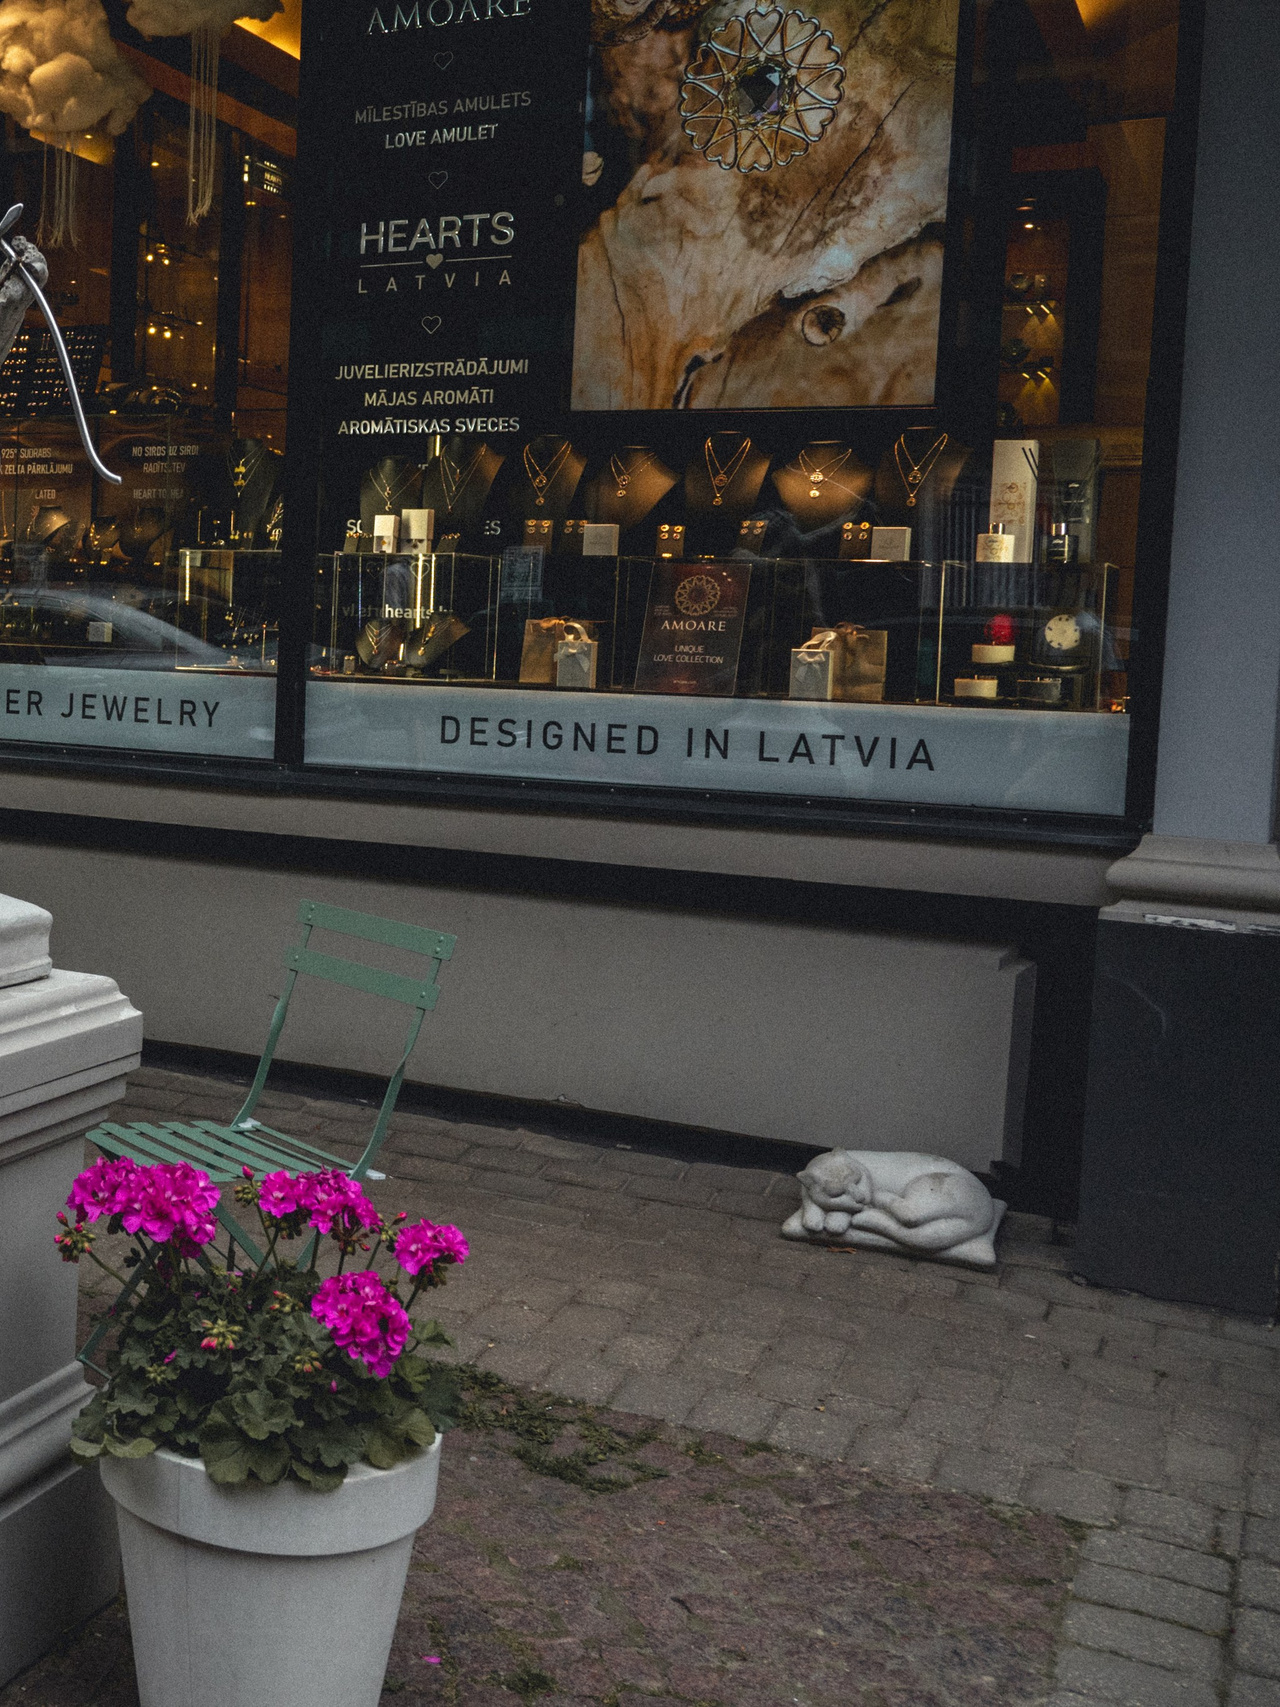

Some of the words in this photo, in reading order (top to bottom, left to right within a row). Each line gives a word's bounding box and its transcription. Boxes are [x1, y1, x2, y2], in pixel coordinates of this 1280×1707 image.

[366, 0, 532, 35] AMOARE
[354, 99, 449, 125] MĪLESTĪBAS
[453, 91, 532, 115] AMULETS
[384, 130, 426, 150] LOVE
[430, 123, 499, 146] AMULET
[359, 211, 516, 255] HEARTS
[358, 269, 513, 294] LATVIA
[334, 356, 529, 382] JUVELIERIZSTRĀDĀJUMI
[363, 387, 417, 407] MĀJAS
[421, 386, 494, 406] AROMĀTI
[338, 417, 451, 436] AROMĀTISKAS
[455, 416, 521, 434] SVECES
[661, 619, 727, 632] AMOARE
[653, 654, 673, 662] LOVE
[675, 654, 724, 664] COLLECTION
[674, 644, 705, 654] UNIQUE
[60, 692, 221, 728] JEWELRY
[440, 715, 660, 756] DESIGNED
[686, 726, 730, 759] IN
[759, 730, 935, 772] LATVIA
